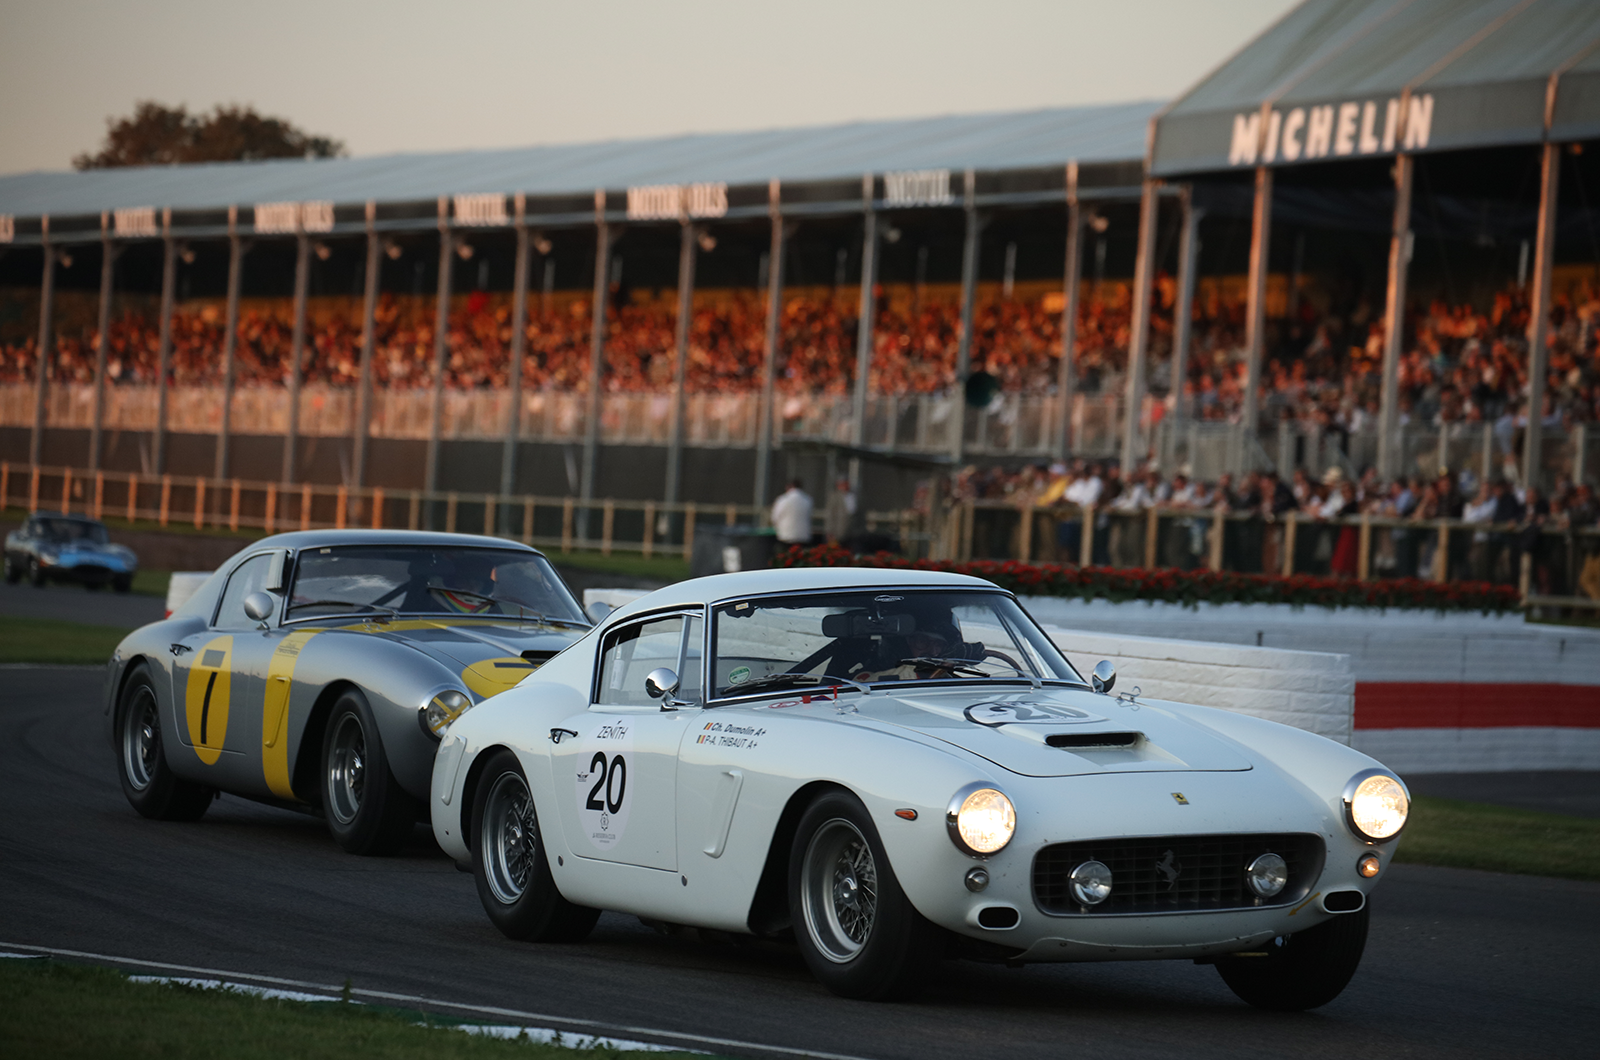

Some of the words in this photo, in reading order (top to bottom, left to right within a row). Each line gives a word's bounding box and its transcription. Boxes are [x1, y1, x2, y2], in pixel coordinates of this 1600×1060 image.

[1229, 94, 1434, 165] MICHELIN
[597, 726, 628, 739] ZENITH
[718, 736, 748, 748] THIBAUT
[586, 751, 626, 814] 20
